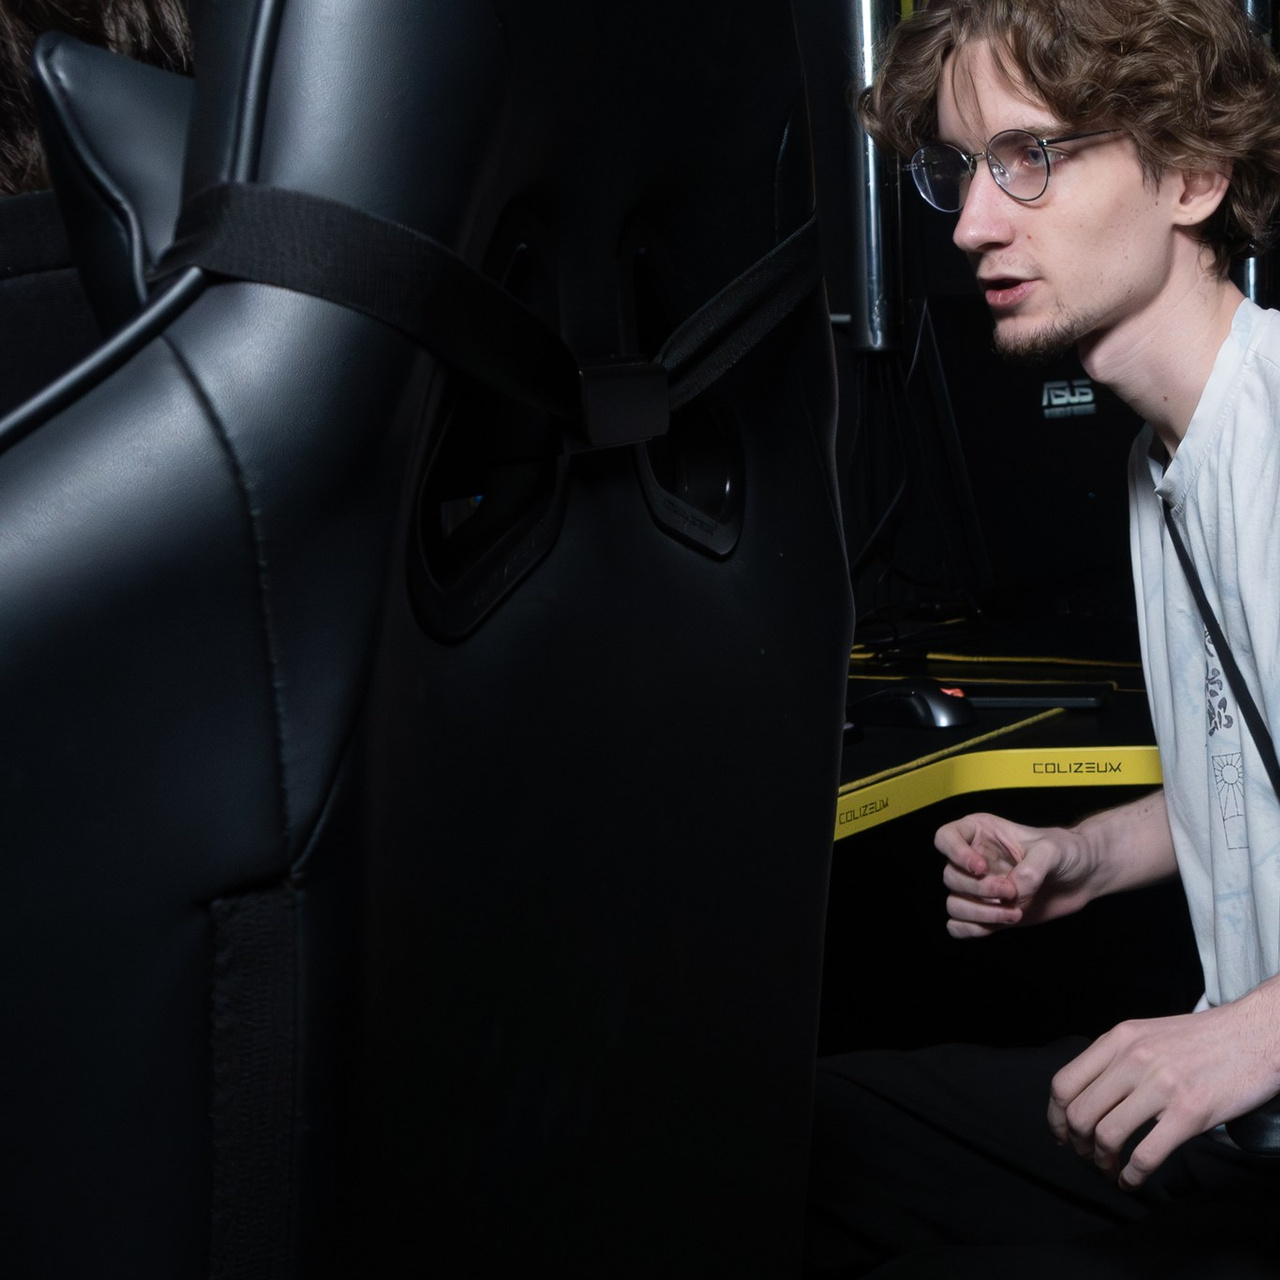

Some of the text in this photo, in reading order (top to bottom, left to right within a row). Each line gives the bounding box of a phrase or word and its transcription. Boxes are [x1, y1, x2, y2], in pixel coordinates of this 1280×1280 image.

[1041, 378, 1095, 407] ASUS
[1032, 762, 1123, 774] COLIZEUM
[838, 796, 889, 826] COLIZEUM
